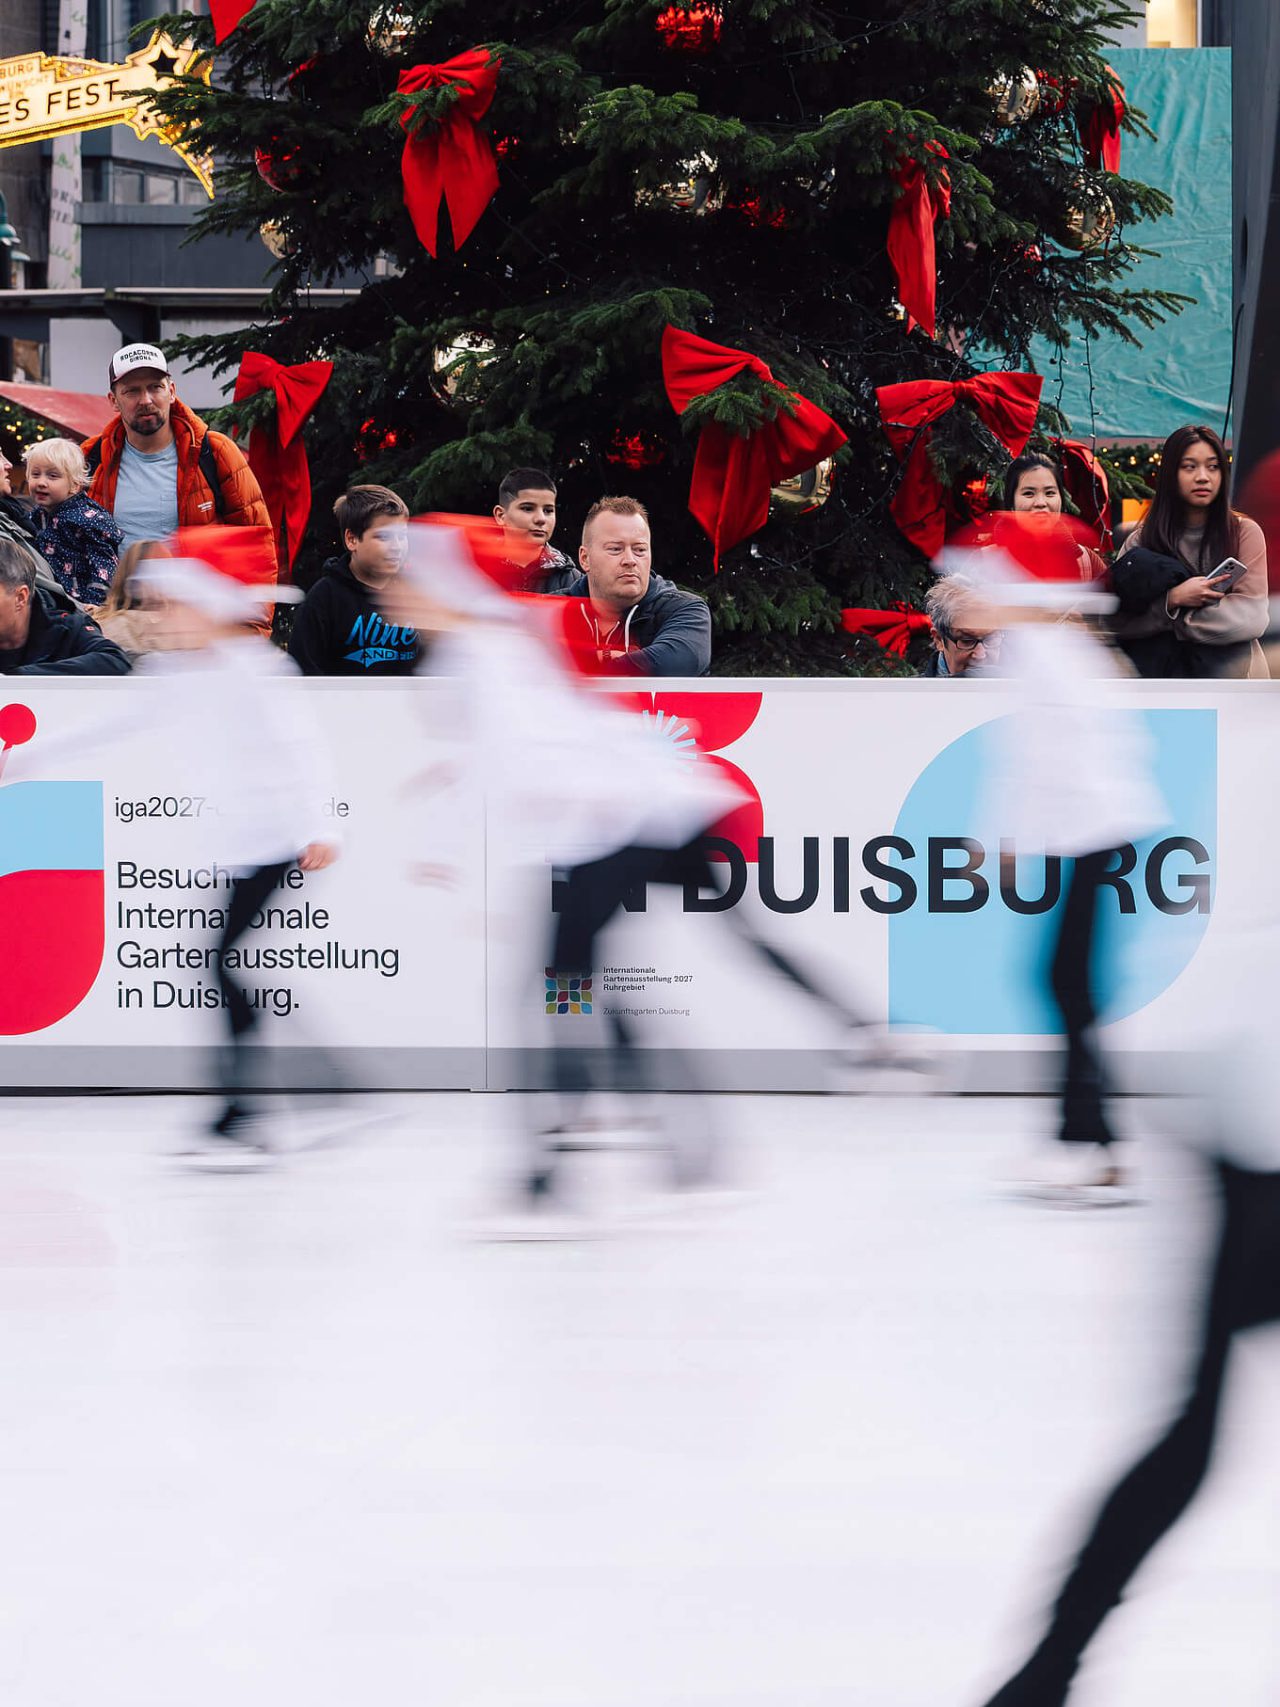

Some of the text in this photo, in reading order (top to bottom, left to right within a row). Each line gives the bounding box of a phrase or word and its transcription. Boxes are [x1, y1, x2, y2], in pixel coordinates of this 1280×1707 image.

[47, 79, 120, 115] FEST
[345, 611, 416, 646] Nine
[117, 861, 255, 889] Besuch
[682, 835, 1212, 915] DUISBURG
[117, 901, 329, 929] Internaonale
[116, 941, 399, 977] Gartenausstellung
[603, 975, 693, 984] Gartenausstellung 2027
[603, 984, 645, 992] Ruhrgebiet
[117, 981, 143, 1009] in
[603, 1007, 690, 1016] Zukunftsgarten Duisburg
